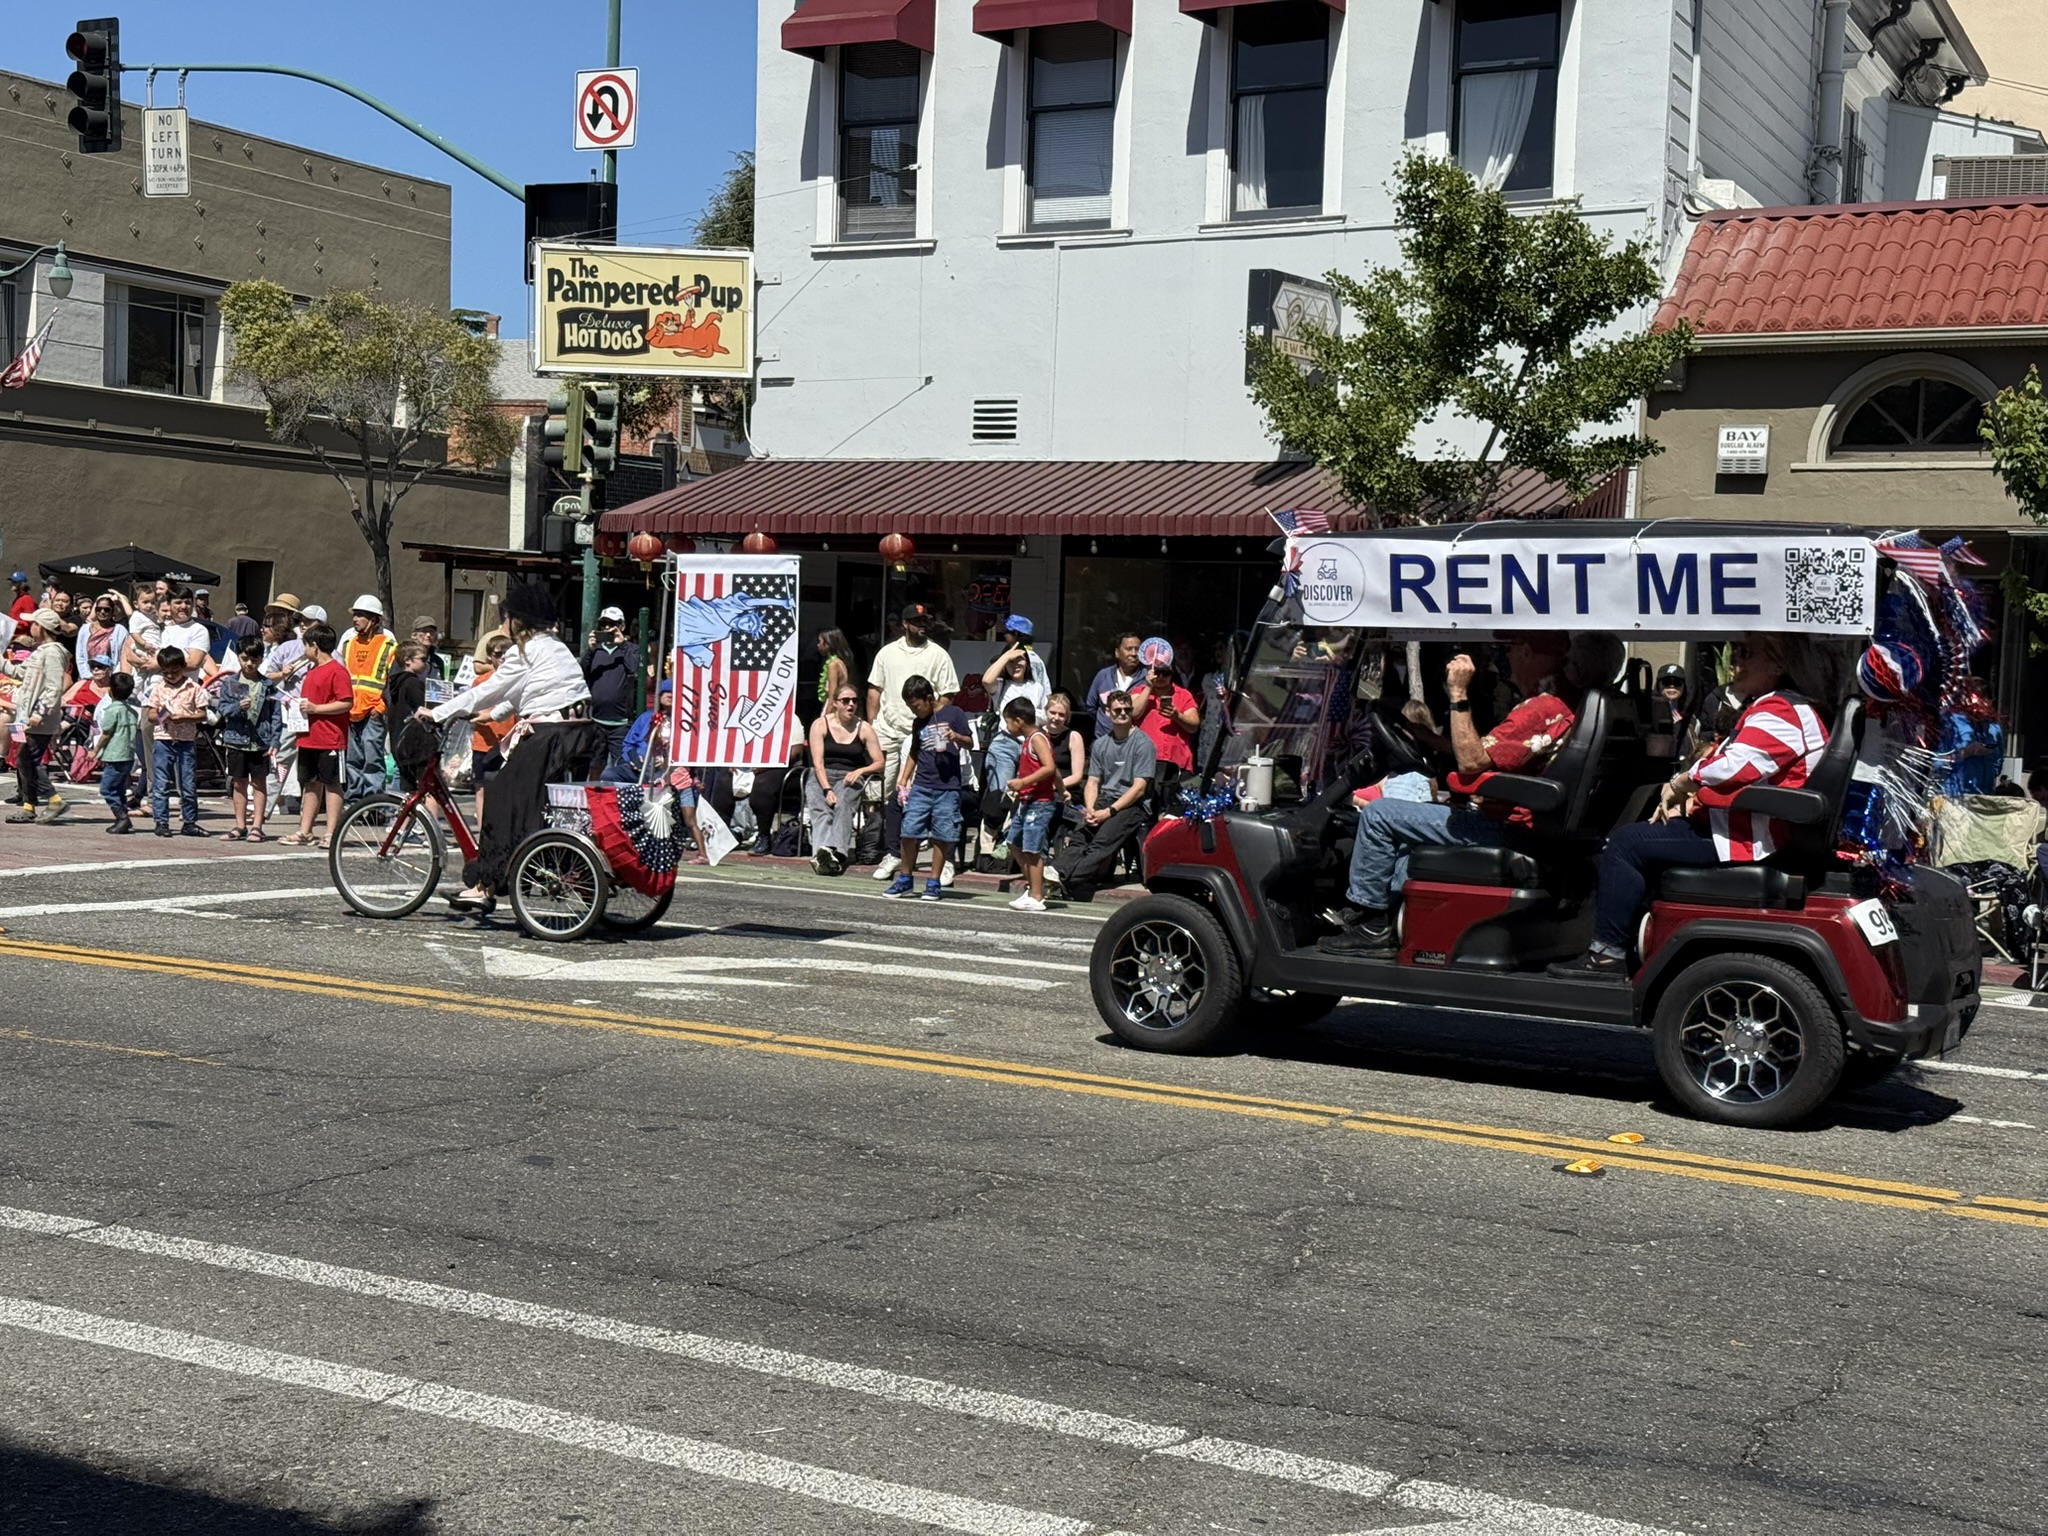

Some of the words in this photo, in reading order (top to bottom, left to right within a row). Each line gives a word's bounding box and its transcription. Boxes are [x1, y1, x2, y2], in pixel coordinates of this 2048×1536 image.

[158, 114, 173, 126] NO
[152, 130, 180, 143] LEFT
[151, 147, 182, 159] TURN
[569, 257, 599, 279] The
[547, 267, 681, 309] Pampered
[693, 273, 743, 313] Pup
[578, 312, 634, 330] Deluxe
[564, 323, 598, 349] HOT
[601, 324, 643, 350] DOGS
[1726, 431, 1762, 441] BAY
[1303, 584, 1353, 601] DISCOVER
[1389, 552, 1606, 615] RENT
[1635, 552, 1762, 616] ME
[776, 654, 796, 679] NO
[679, 683, 700, 736] 1776
[707, 680, 727, 732] Since
[748, 683, 785, 731] KINGS
